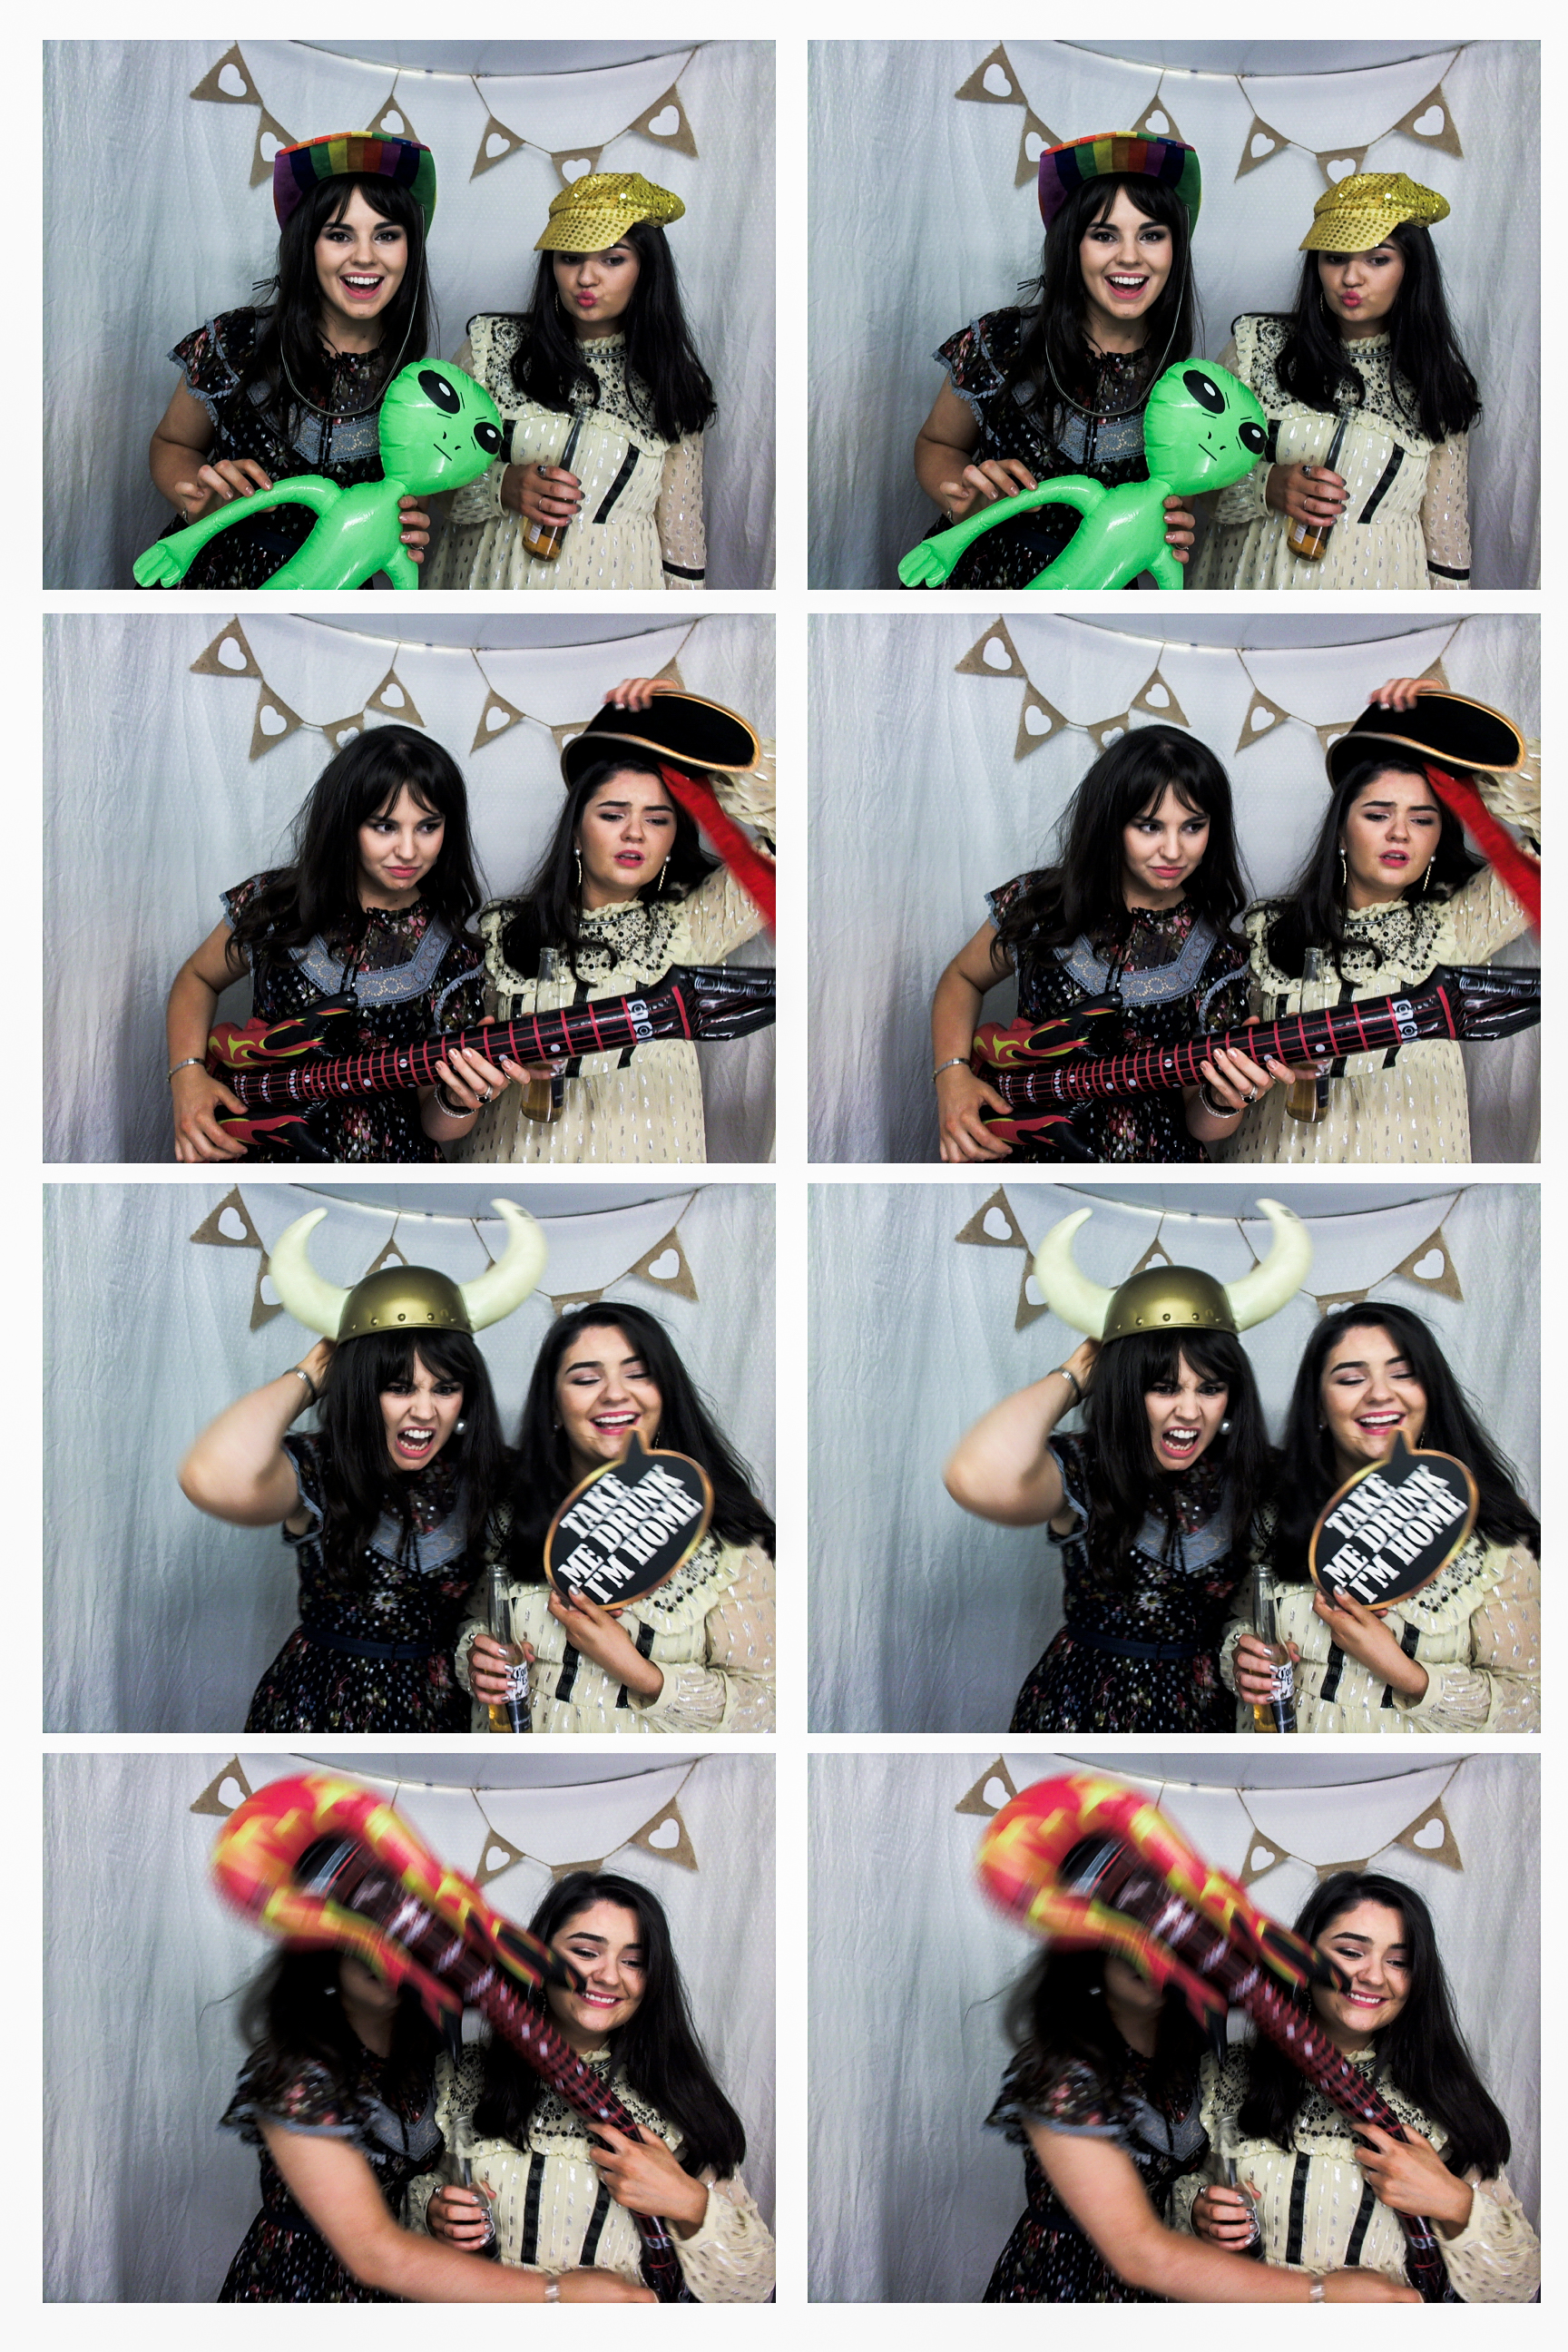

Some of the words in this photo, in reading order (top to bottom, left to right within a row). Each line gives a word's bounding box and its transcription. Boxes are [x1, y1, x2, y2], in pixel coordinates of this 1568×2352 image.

[557, 1543, 604, 1588] ME
[589, 1464, 685, 1553] DRUNK
[559, 1473, 632, 1539] TAKE
[583, 1554, 635, 1603] I'M
[620, 1487, 703, 1566] HOME
[1322, 1543, 1369, 1588] ME
[1354, 1464, 1450, 1553] DRUNK
[1324, 1473, 1397, 1539] TAKE
[1348, 1554, 1400, 1603] I'M
[1385, 1487, 1468, 1566] HOME
